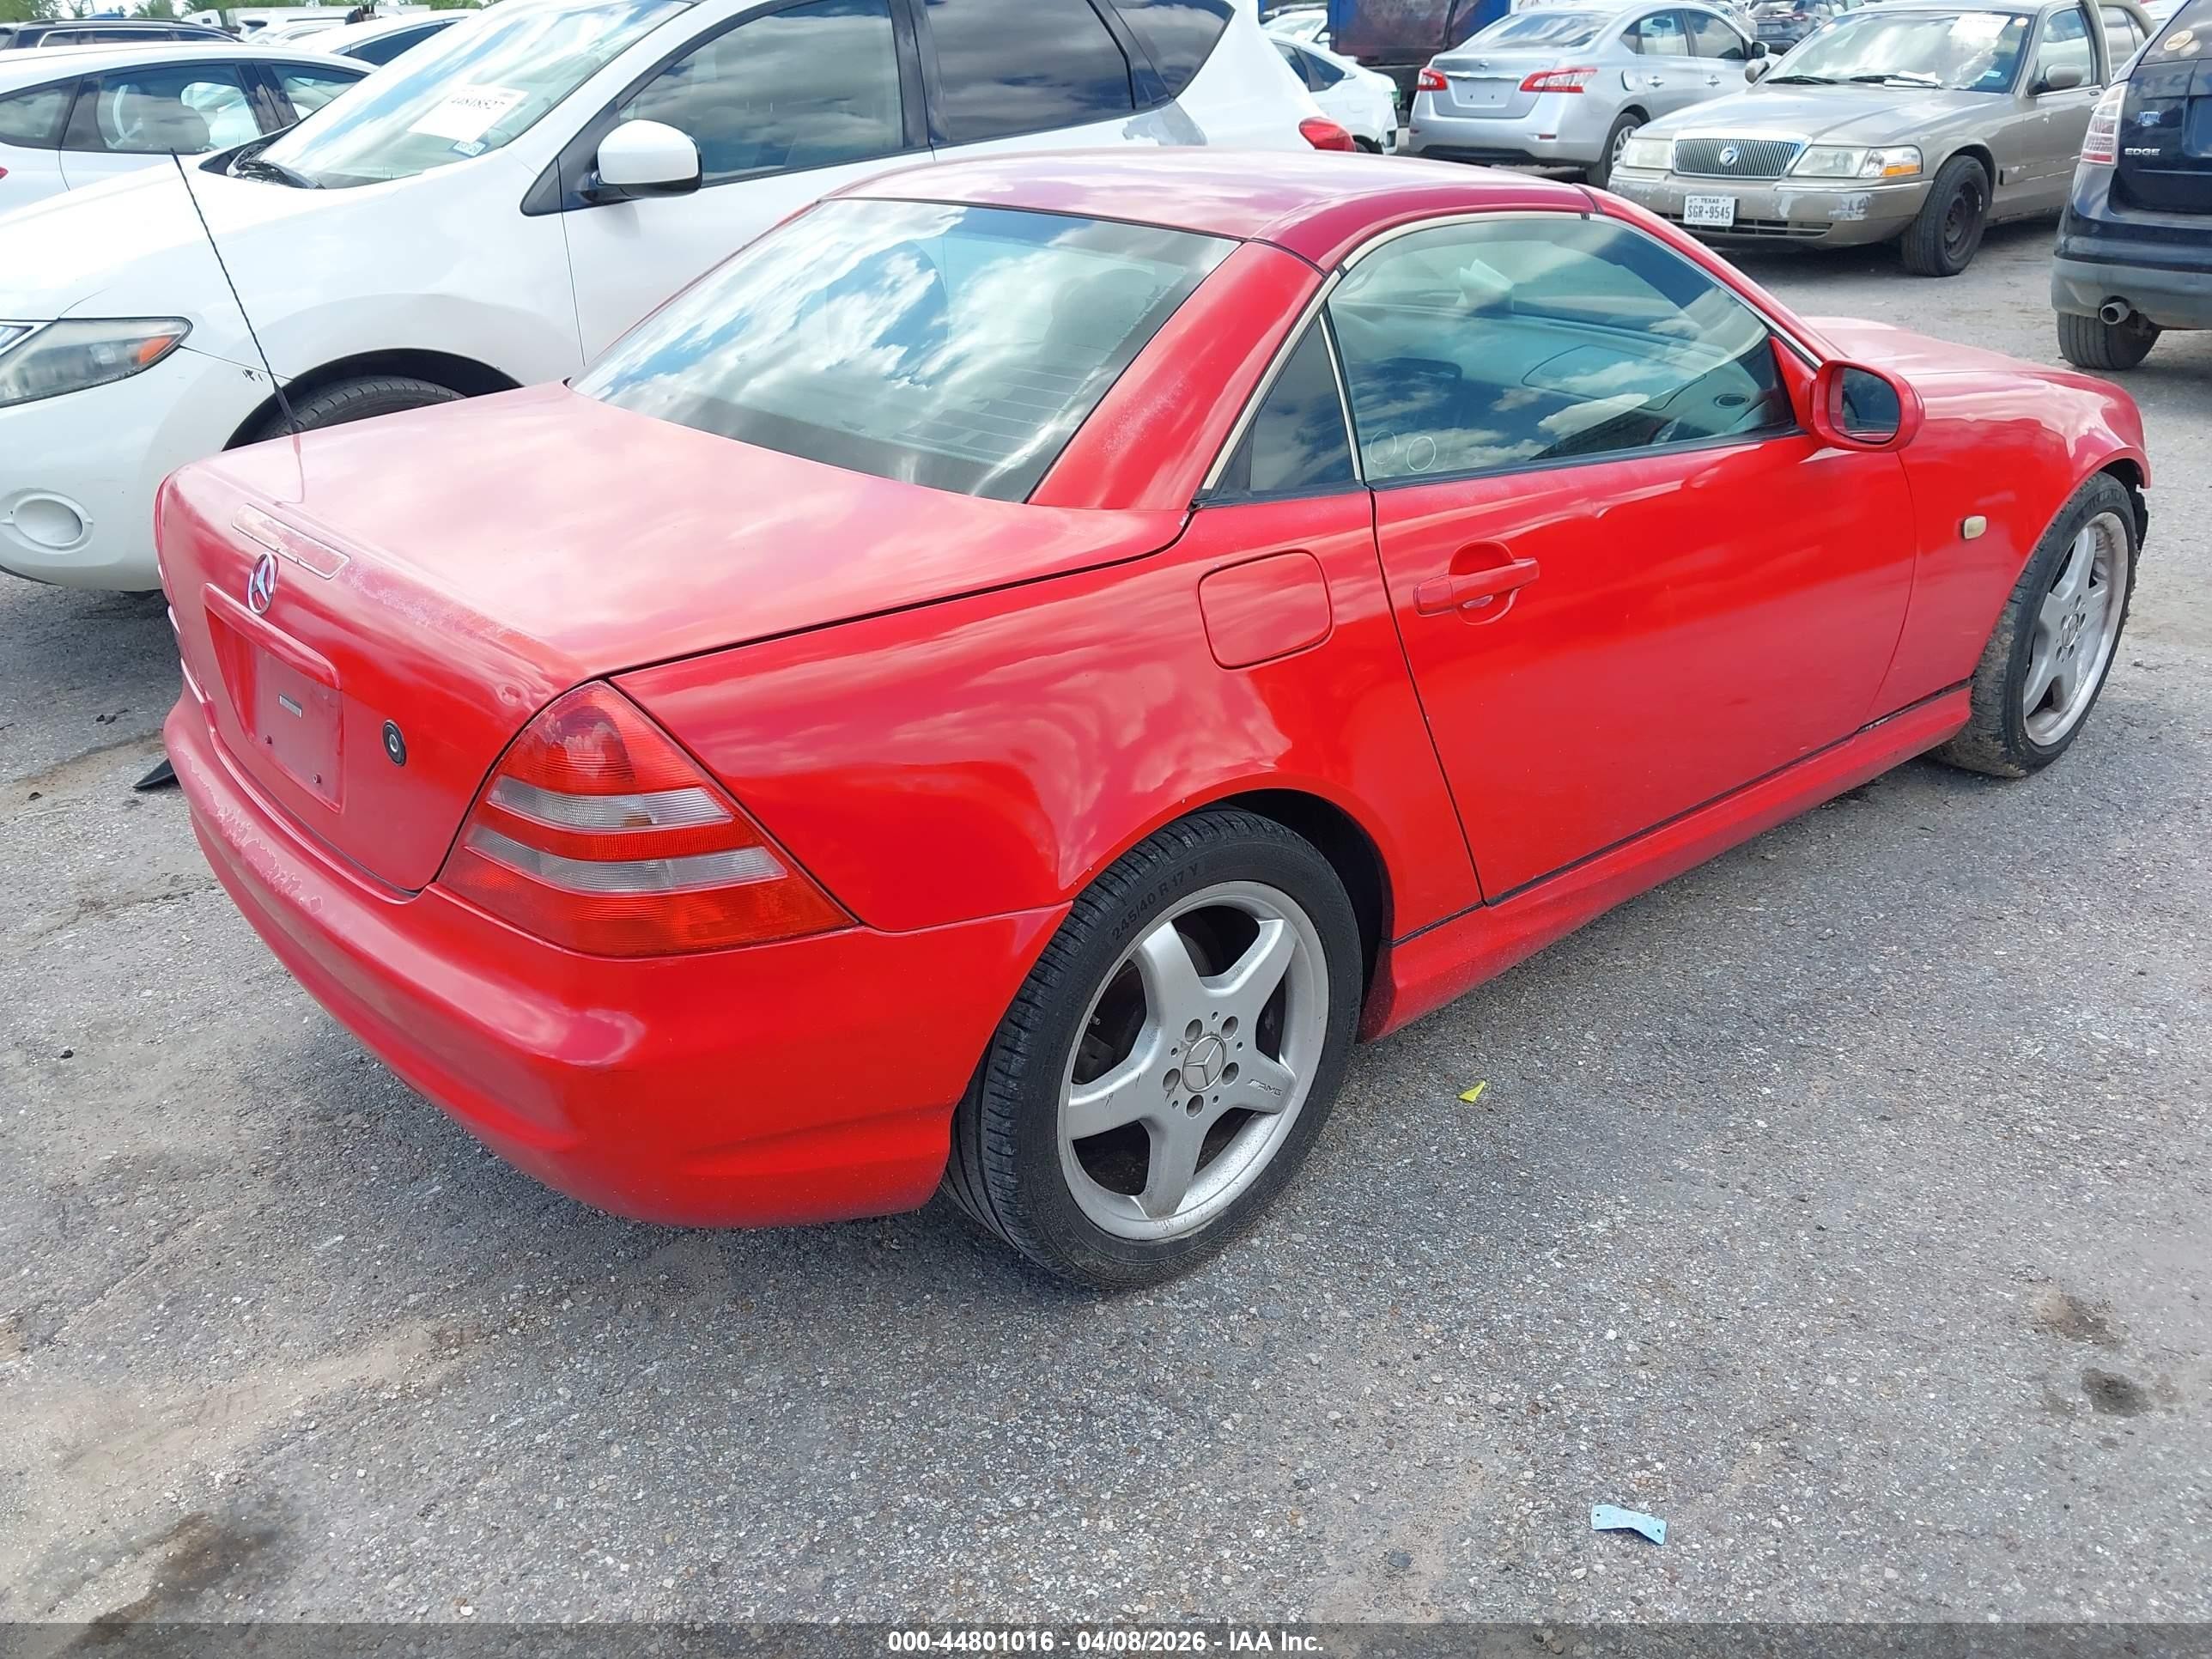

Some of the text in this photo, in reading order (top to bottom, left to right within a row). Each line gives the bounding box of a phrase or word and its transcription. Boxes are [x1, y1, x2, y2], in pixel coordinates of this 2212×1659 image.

[2124, 148, 2161, 156] EDGE
[1111, 892, 1157, 941] 245/40
[1158, 881, 1170, 896] R
[1171, 870, 1186, 887] 17
